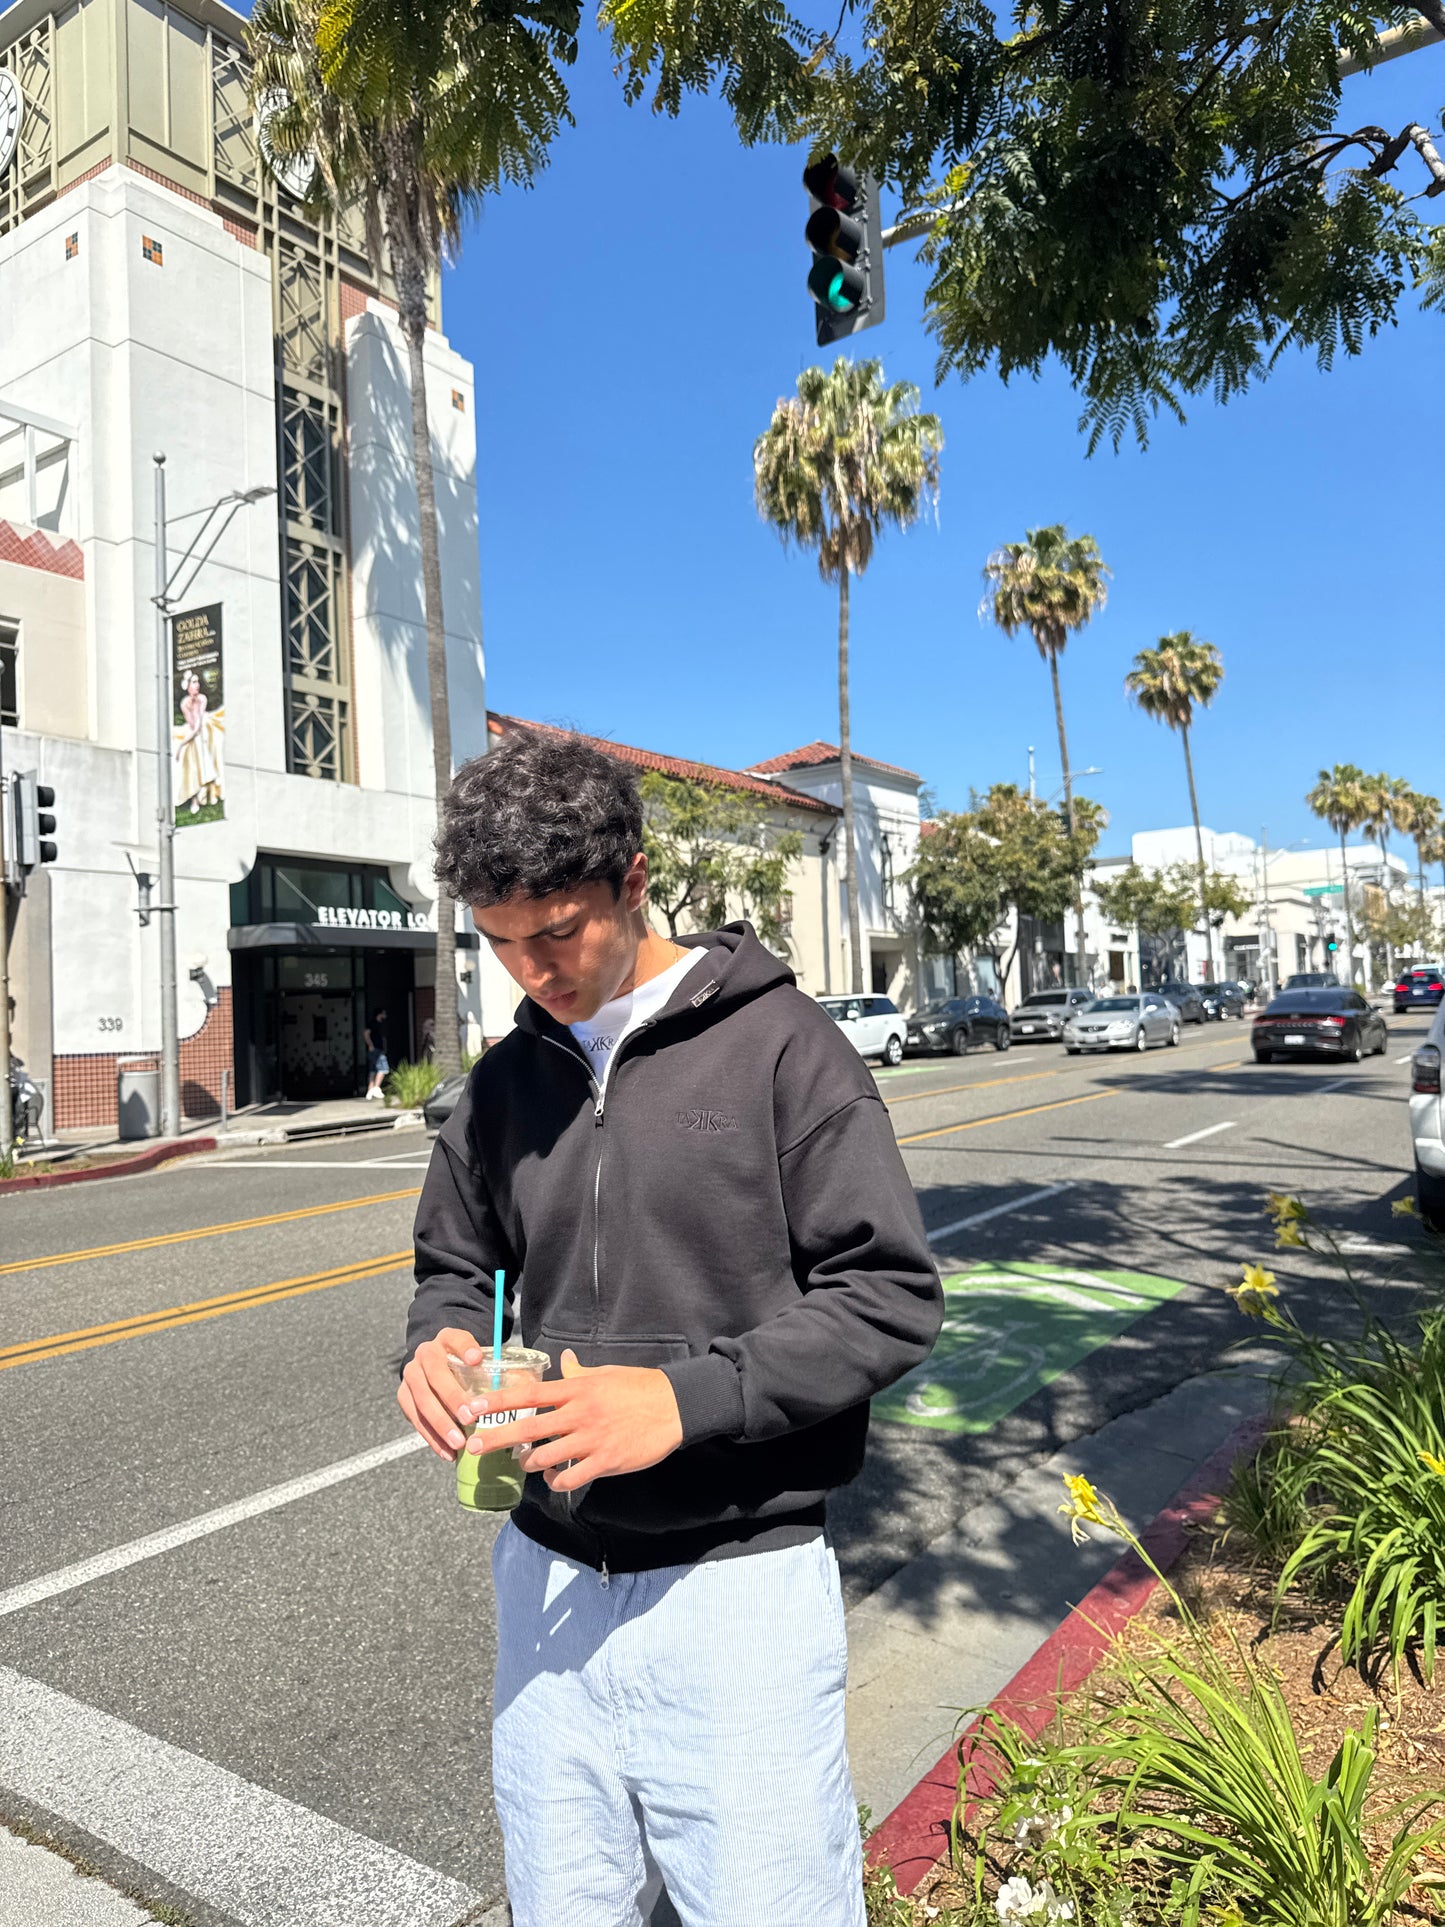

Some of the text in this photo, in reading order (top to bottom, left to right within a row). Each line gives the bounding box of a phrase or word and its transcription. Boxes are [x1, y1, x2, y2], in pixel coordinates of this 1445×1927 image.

[317, 906, 402, 929] ELEVATOR
[304, 973, 328, 987] 345
[98, 1017, 123, 1032] 339
[582, 1036, 617, 1051] TAKKR
